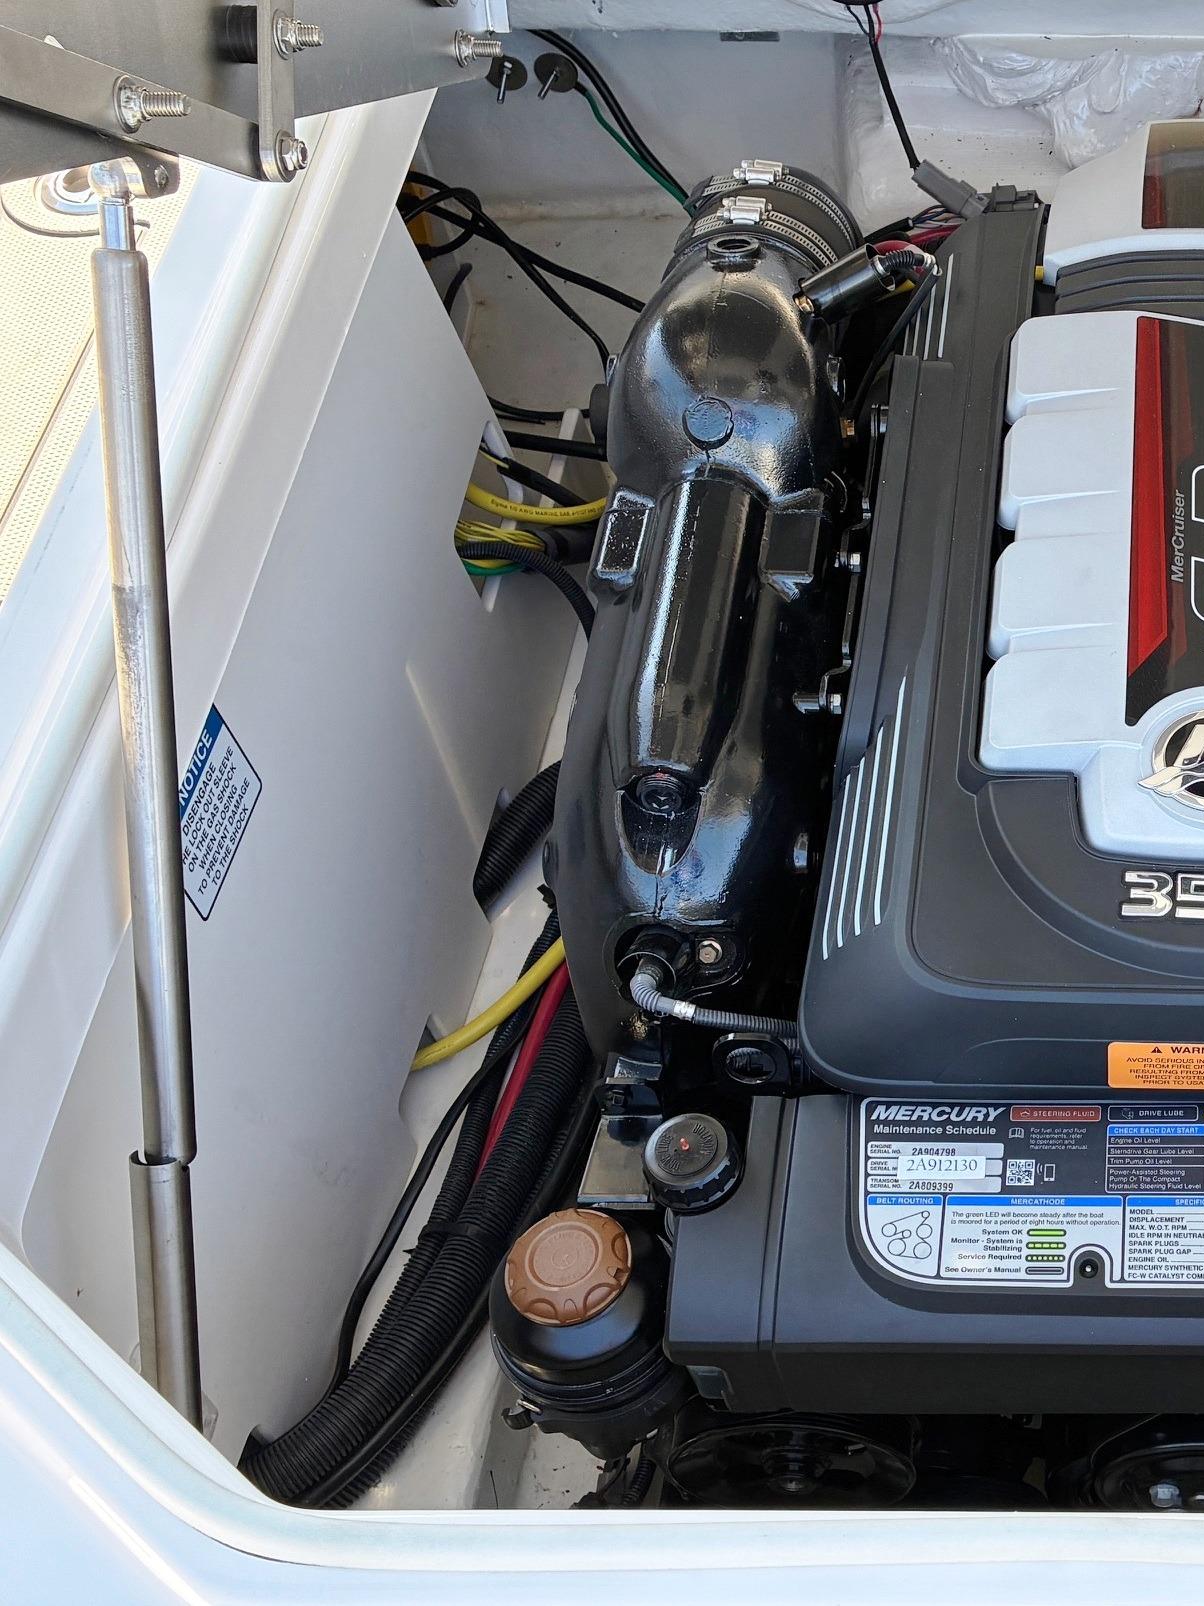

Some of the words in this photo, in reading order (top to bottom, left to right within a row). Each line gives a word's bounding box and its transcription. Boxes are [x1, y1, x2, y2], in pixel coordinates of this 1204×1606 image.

[1171, 489, 1185, 582] MerCruiser
[179, 729, 212, 806] NOTICE
[182, 761, 217, 836] DISENGAGE
[182, 847, 193, 865] HE
[189, 816, 206, 847] LOCK
[203, 791, 216, 814] OUT
[213, 746, 234, 790] SLEEVE
[188, 855, 199, 872] ON
[196, 831, 209, 853] THE
[208, 805, 220, 830] GAS
[217, 764, 237, 802] SHOCK
[198, 878, 207, 895] TO
[206, 827, 230, 877] PREVENT
[228, 777, 250, 825] DAMAGE
[199, 835, 217, 870] WHEN
[215, 784, 238, 833] CLOSING
[212, 872, 221, 886] TO
[219, 848, 232, 869] THE
[231, 806, 250, 846] SHOCK
[871, 1105, 1006, 1121] MERCURY
[874, 1125, 943, 1134] Maintenance
[946, 1126, 996, 1135] Schedule
[912, 1147, 956, 1156] 2A904798
[906, 1158, 978, 1172] 2A912130
[909, 1182, 953, 1191] 2A809399
